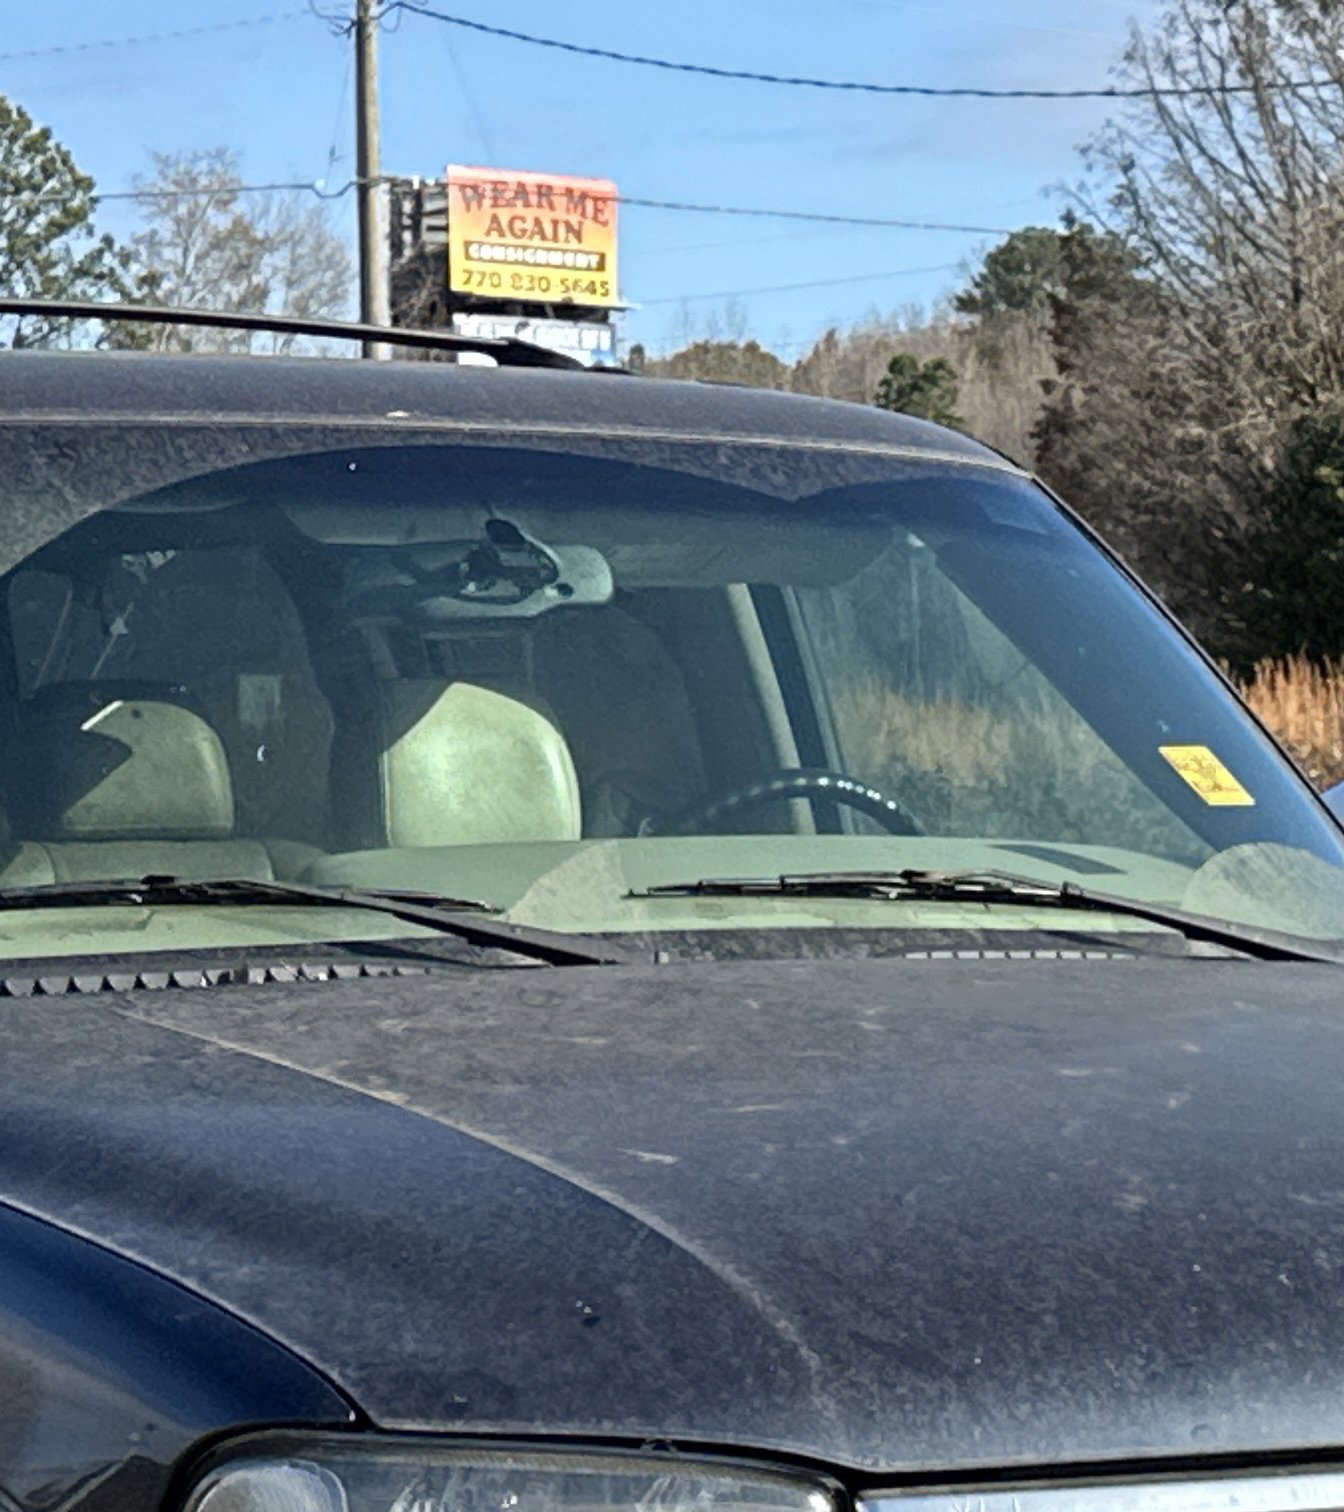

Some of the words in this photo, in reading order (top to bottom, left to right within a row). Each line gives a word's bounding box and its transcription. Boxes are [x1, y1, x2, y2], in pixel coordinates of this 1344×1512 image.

[459, 180, 556, 213] WEAR
[566, 187, 610, 228] ME
[484, 213, 585, 245] AGAIN
[462, 269, 501, 288] 770
